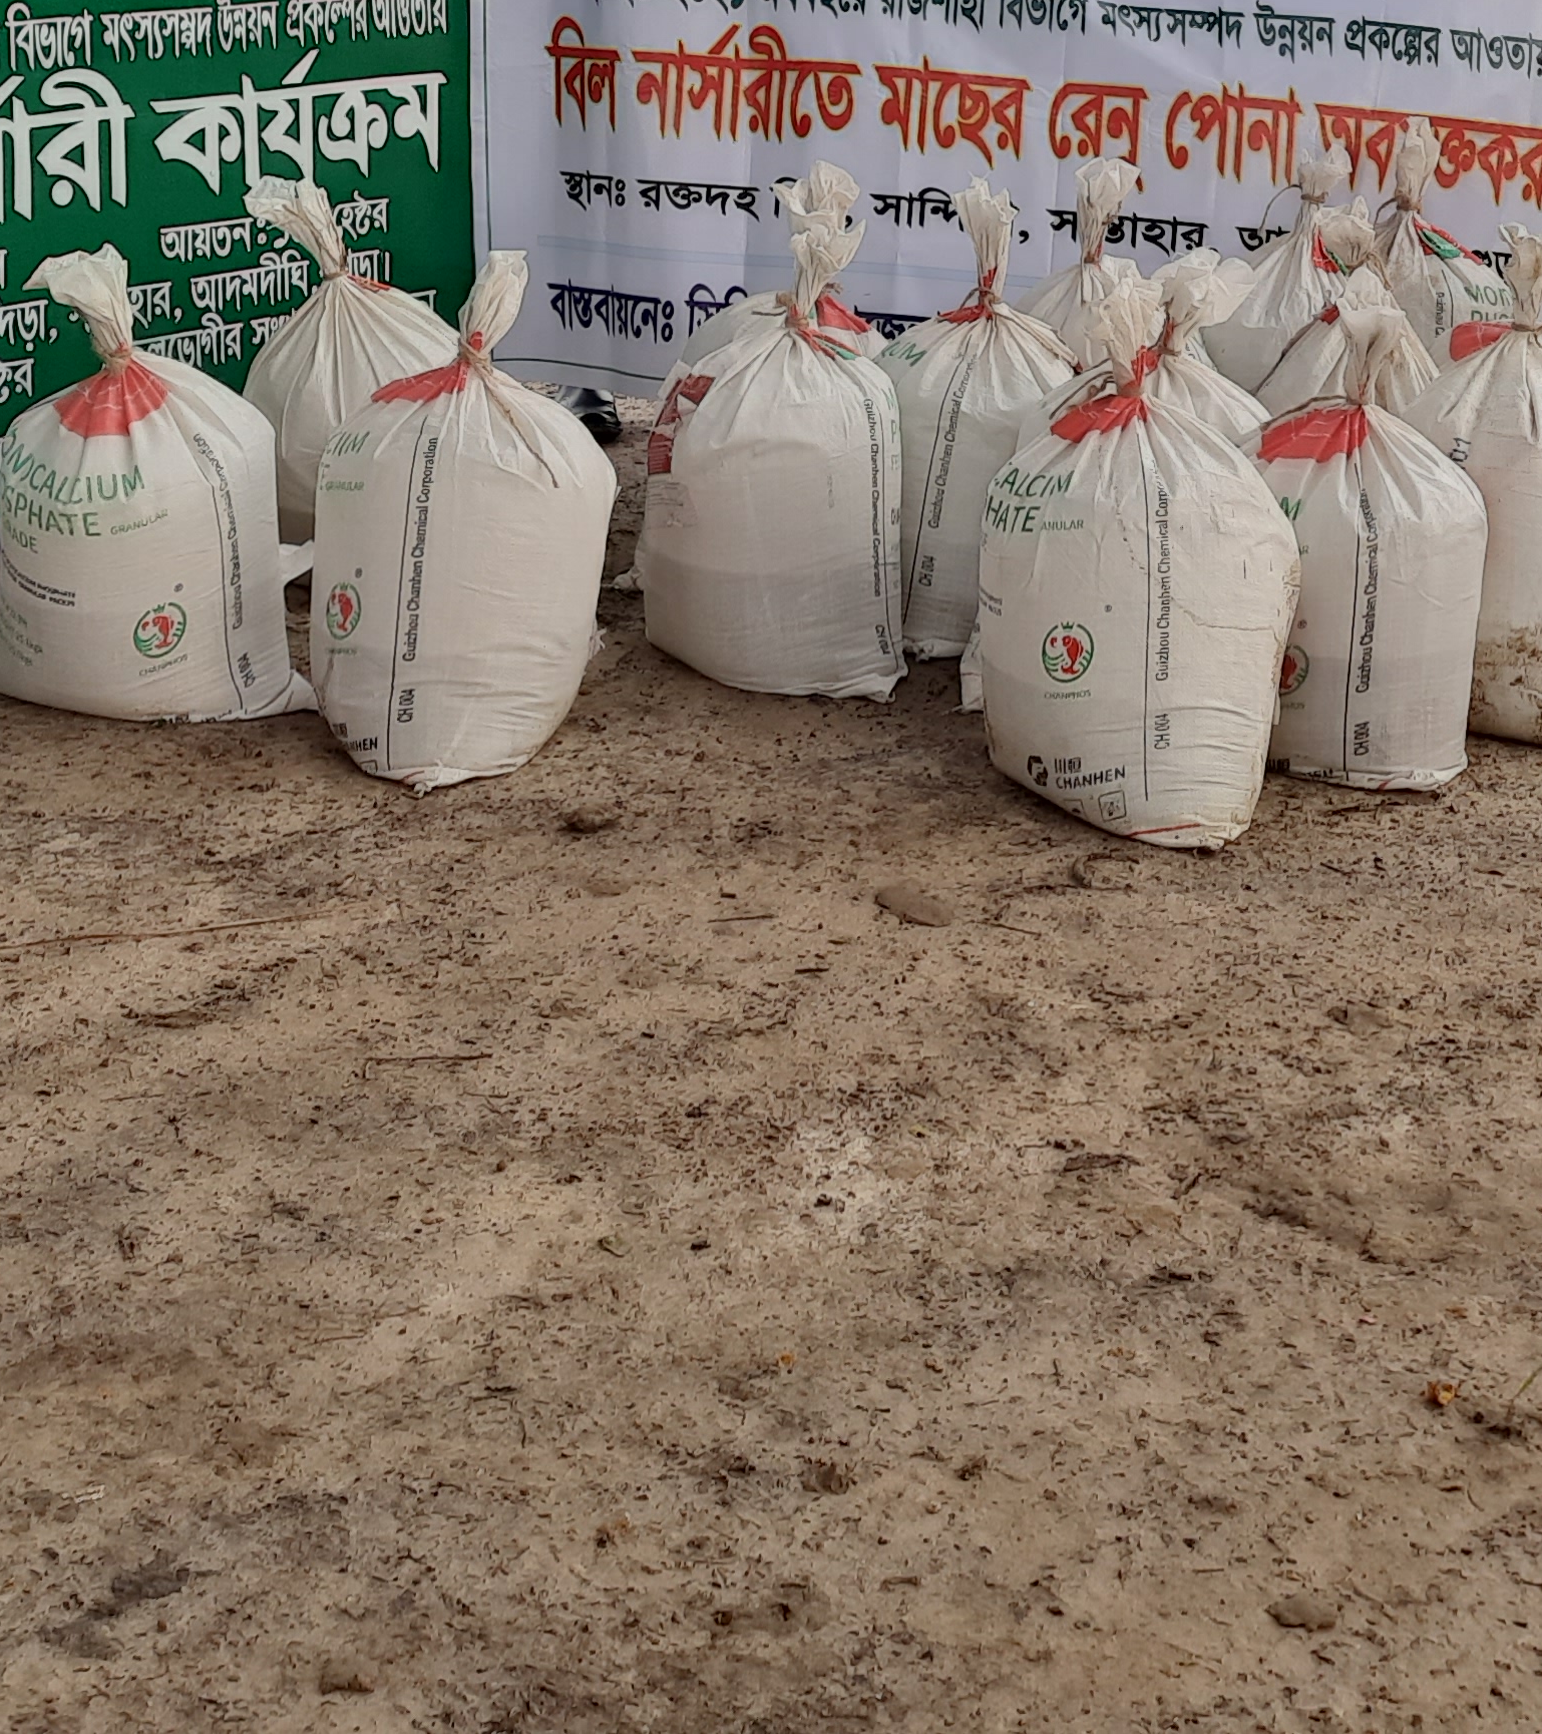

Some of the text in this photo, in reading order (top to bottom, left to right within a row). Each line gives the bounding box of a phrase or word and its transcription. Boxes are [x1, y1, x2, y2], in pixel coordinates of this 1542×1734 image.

[5, 1, 94, 72] বিভাগে
[1253, 0, 1336, 64] উন্নয়ন
[1345, 16, 1441, 67] প্রকল্পের
[149, 48, 448, 196] কার্যক্রম
[546, 16, 621, 131] বিল
[630, 23, 861, 142] নার্সারীতে
[873, 55, 1030, 170] মাছের
[1166, 81, 1304, 187] পোনা
[559, 170, 625, 211] স্থানঃ
[635, 179, 760, 222] রক্তদহ
[547, 279, 674, 344] বাস্তবায়নেঃ
[863, 398, 877, 441] Guizhou
[870, 443, 880, 487] Chanhen
[928, 400, 963, 529] Guizhou Chanhen Chemical
[110, 508, 169, 536] GRANULAR
[1041, 519, 1084, 532] ANULAR
[402, 437, 439, 661] Guizhou Chanhen Chemical Corporation
[1363, 544, 1379, 594] Chemical
[918, 572, 933, 587] CH
[1155, 521, 1172, 681] Guizhou Chanhen Chemical
[1359, 596, 1377, 646] Chanhen
[241, 670, 256, 688] CH
[1354, 647, 1373, 693] Guizhou
[397, 689, 415, 723] CH 004
[1154, 713, 1170, 749] CH 004
[1354, 722, 1370, 756] CH 004
[1056, 764, 1126, 790] CHANHEN
